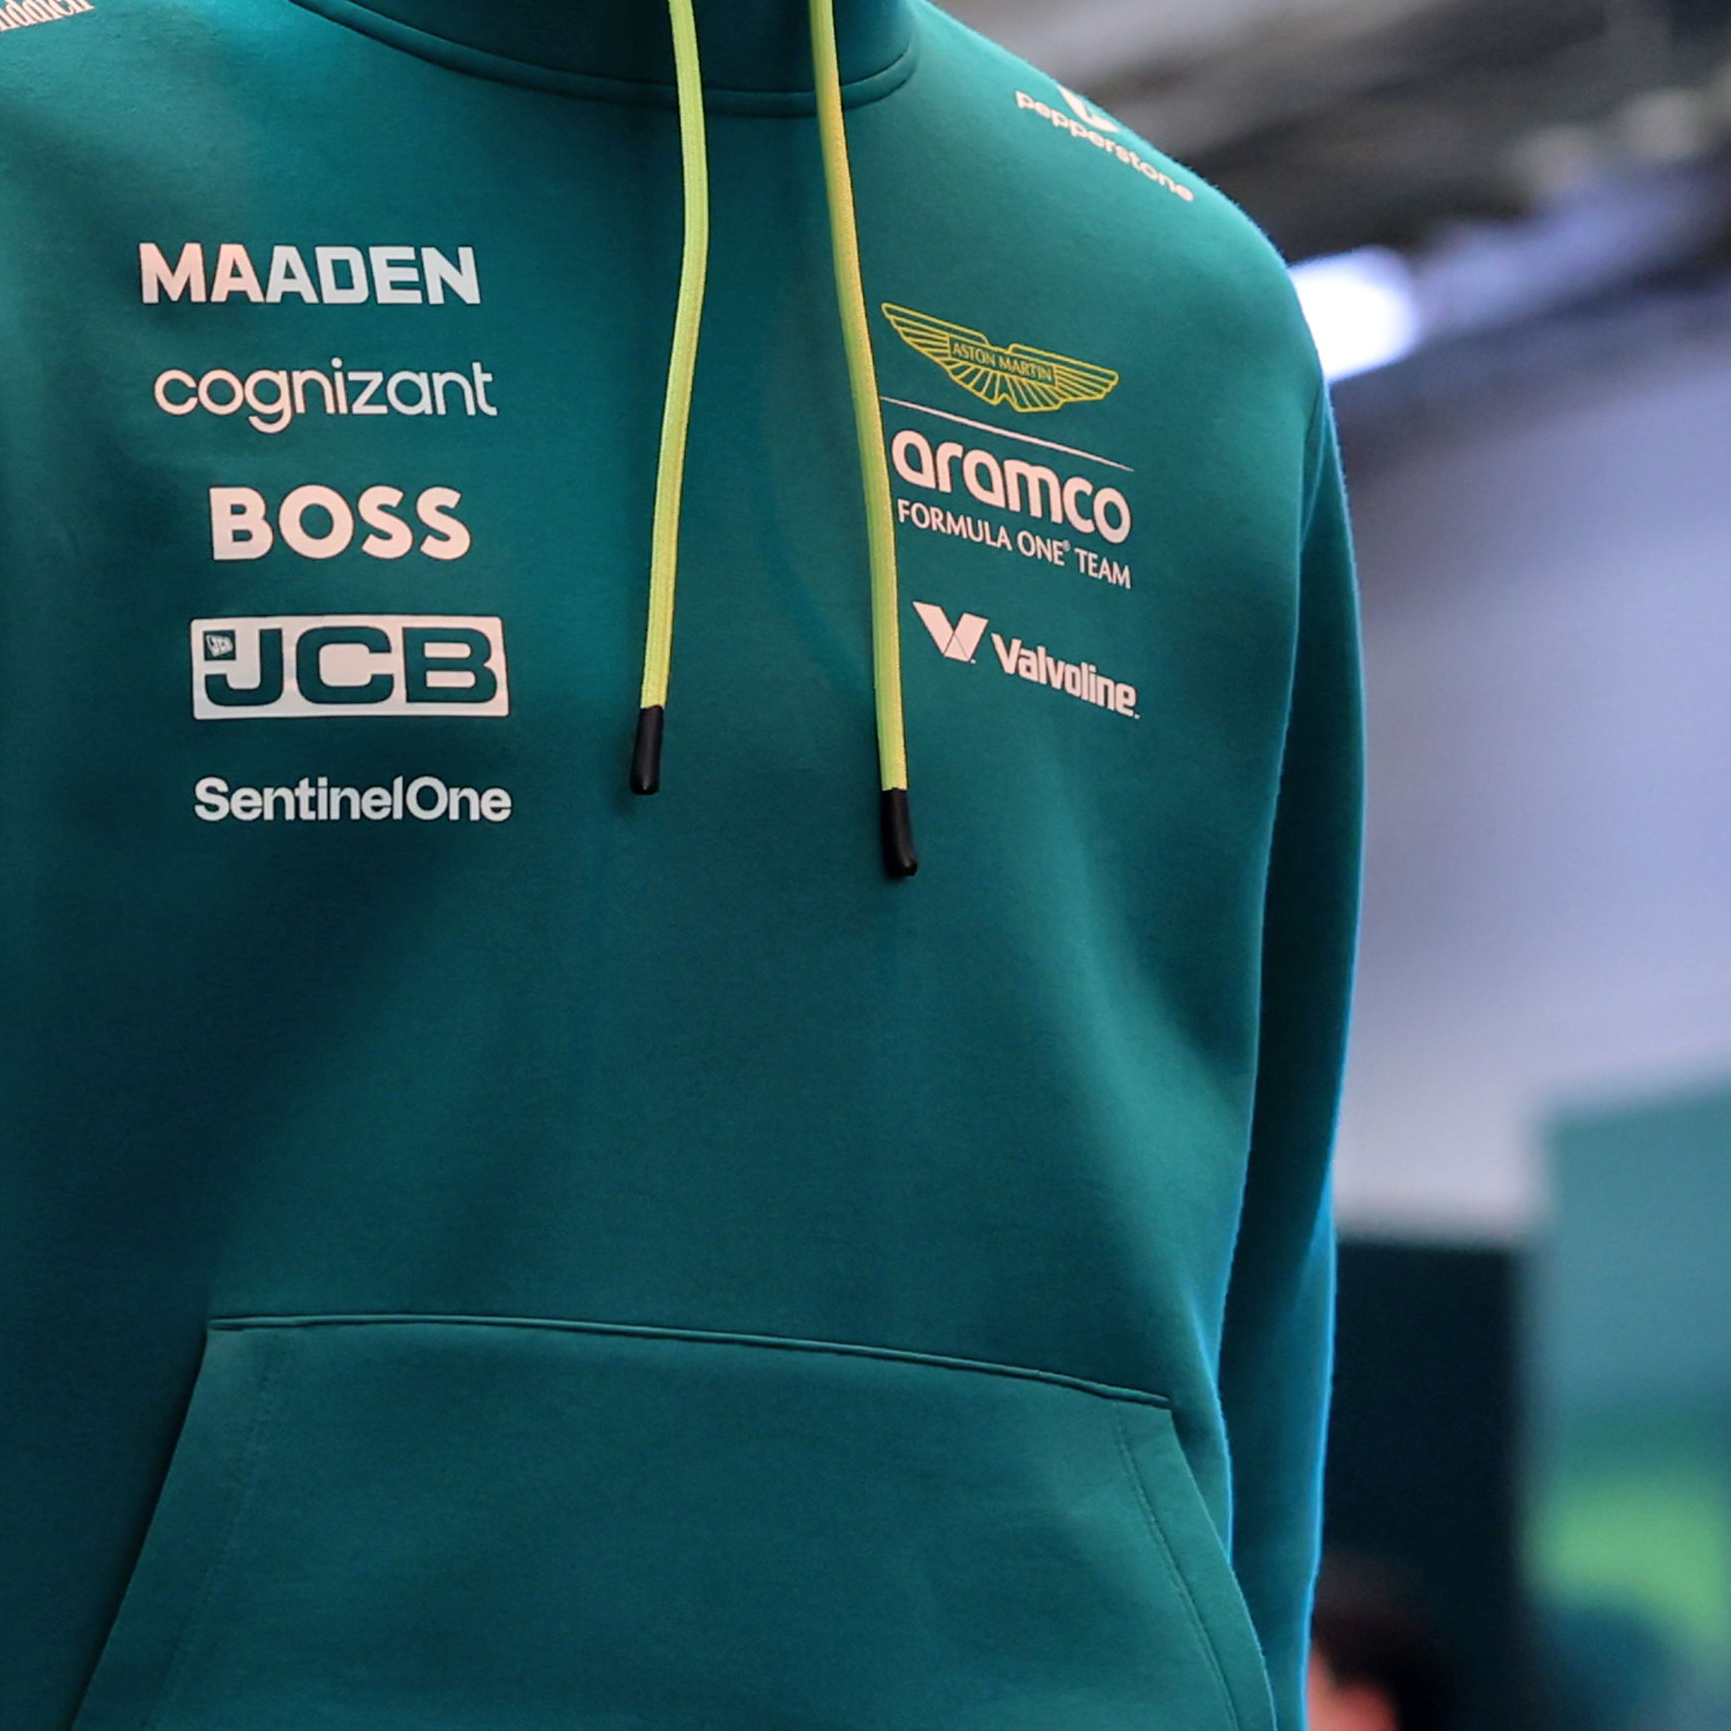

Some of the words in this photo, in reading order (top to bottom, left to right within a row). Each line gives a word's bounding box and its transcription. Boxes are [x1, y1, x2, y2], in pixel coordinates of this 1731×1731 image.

[1015, 90, 1195, 202] pepperstone
[138, 242, 481, 305] MAADEN
[154, 357, 497, 433] cognizant
[953, 341, 997, 367] ASTON
[999, 355, 1053, 382] MARTIN
[208, 484, 471, 560] BOSS
[891, 429, 1131, 544] aramco
[897, 499, 1013, 551] FORMULA
[1074, 547, 1131, 589] TEAM
[204, 625, 497, 707] JCB
[194, 775, 513, 821] SentinelOne
